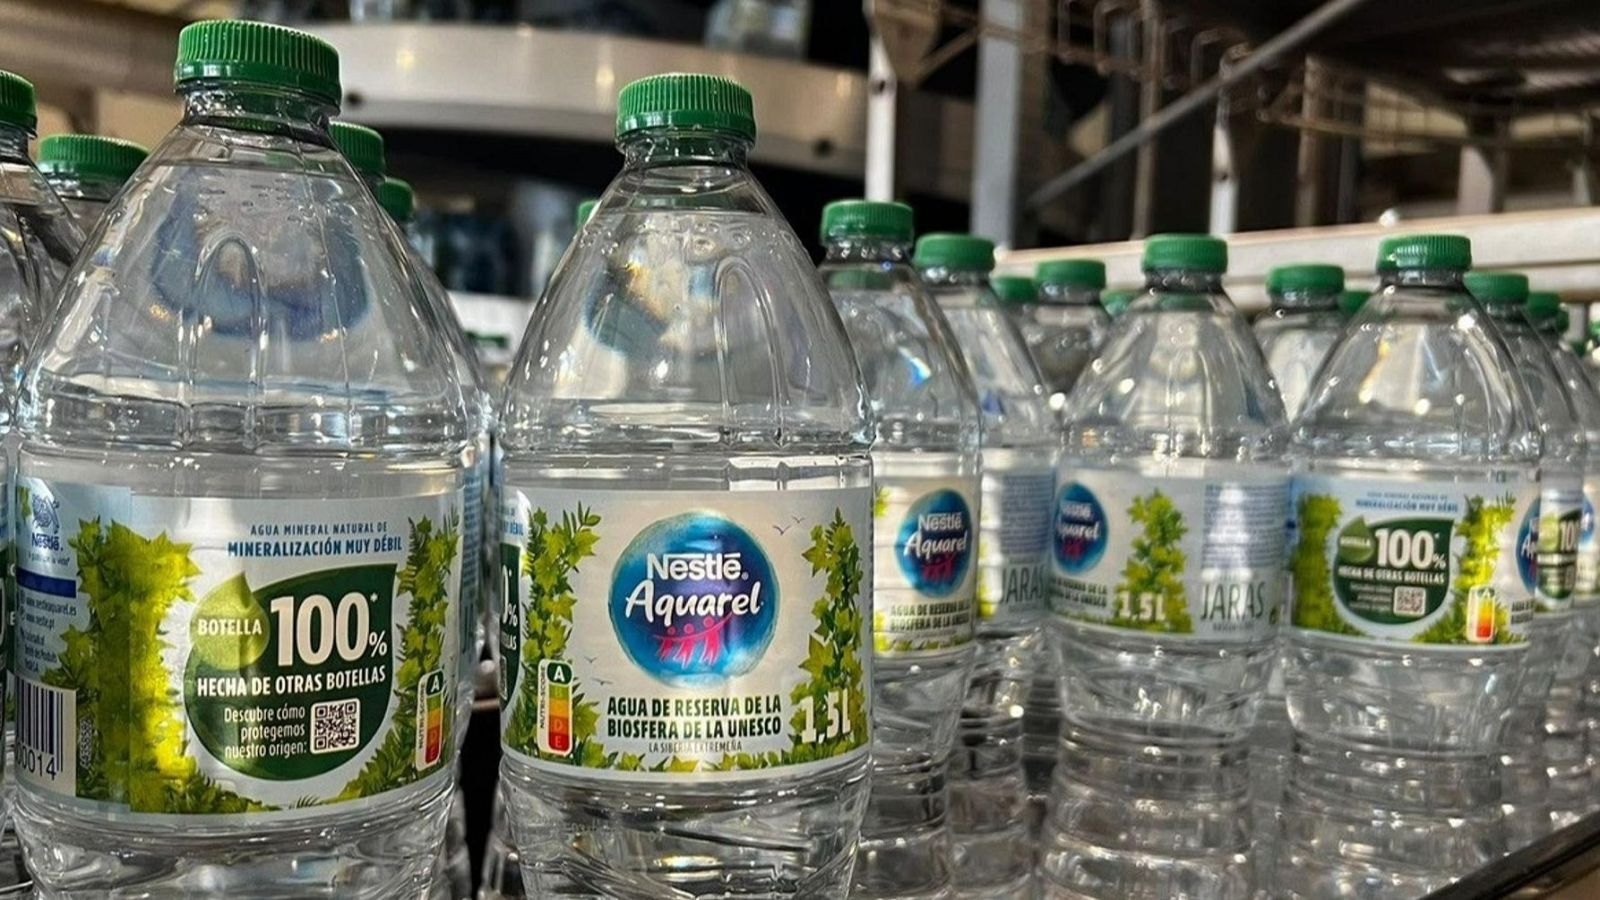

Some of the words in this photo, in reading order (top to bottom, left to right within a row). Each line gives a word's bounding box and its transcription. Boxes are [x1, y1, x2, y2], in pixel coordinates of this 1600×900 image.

[251, 524, 279, 536] AGUA
[284, 523, 329, 536] MINERAL
[333, 521, 374, 534] NATURAL
[376, 521, 388, 532] DE
[918, 511, 963, 531] Nestlé
[228, 537, 341, 557] MINERALIZACIÓN
[345, 539, 370, 554] MUY
[374, 534, 403, 552] DÉBIL
[903, 529, 968, 560] Aquarel
[647, 552, 742, 581] Nestlé
[1001, 565, 1045, 603] JARAS
[625, 579, 762, 627] Aquarel
[891, 603, 916, 616] AGUA
[1201, 580, 1266, 622] JARAS
[198, 617, 263, 636] BOTELLA
[197, 677, 247, 697] HECHA
[251, 676, 271, 696] DE
[275, 673, 323, 695] OTRAS
[326, 664, 386, 690] BOTELLAS
[430, 674, 440, 693] A
[553, 665, 565, 682] A
[224, 706, 274, 723] Descubre
[276, 702, 305, 720] cómo
[607, 696, 648, 717] AGUA
[652, 698, 670, 717] DE
[675, 697, 741, 717] RESERVA
[744, 695, 762, 715] DE
[766, 694, 781, 714] LA
[799, 689, 851, 744] 1,5L
[240, 722, 305, 743] protegemos
[607, 719, 679, 739] BIOSFERA
[683, 719, 701, 739] DE
[706, 719, 724, 739] LA
[728, 716, 781, 738] UNESCO
[225, 743, 265, 759] nuestro
[269, 740, 307, 759] origen:
[649, 740, 659, 753] LA
[694, 739, 742, 753] EXTREMEÑA
